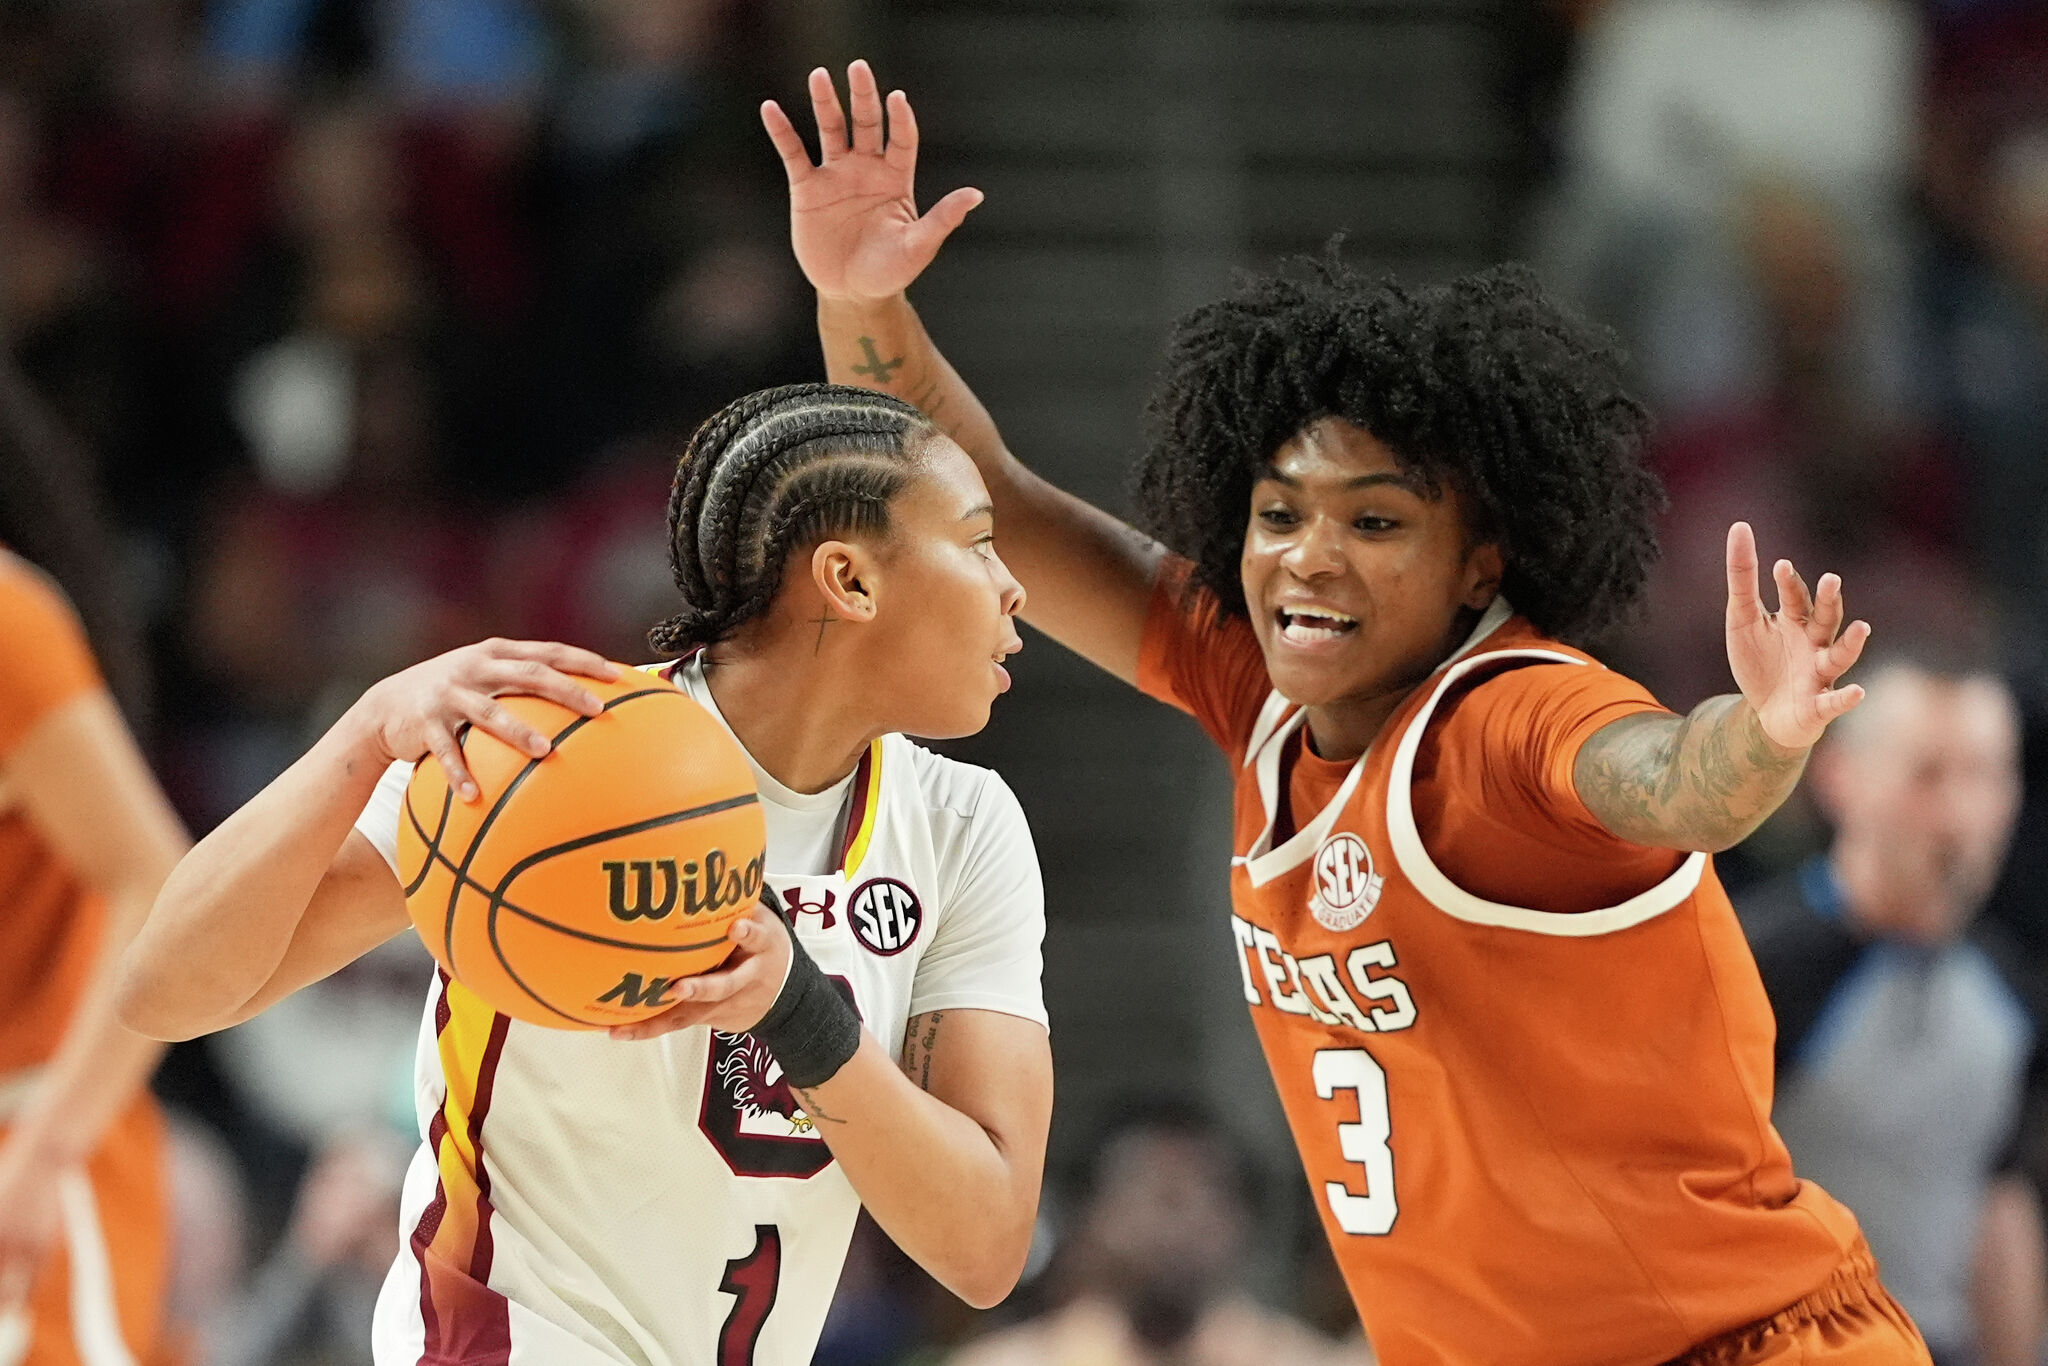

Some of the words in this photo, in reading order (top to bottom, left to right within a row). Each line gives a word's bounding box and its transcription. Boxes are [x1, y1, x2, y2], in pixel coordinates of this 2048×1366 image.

[854, 883, 916, 950] SEC
[1318, 838, 1368, 908] SEC
[1311, 1047, 1399, 1235] 3
[717, 1223, 782, 1366] 1
